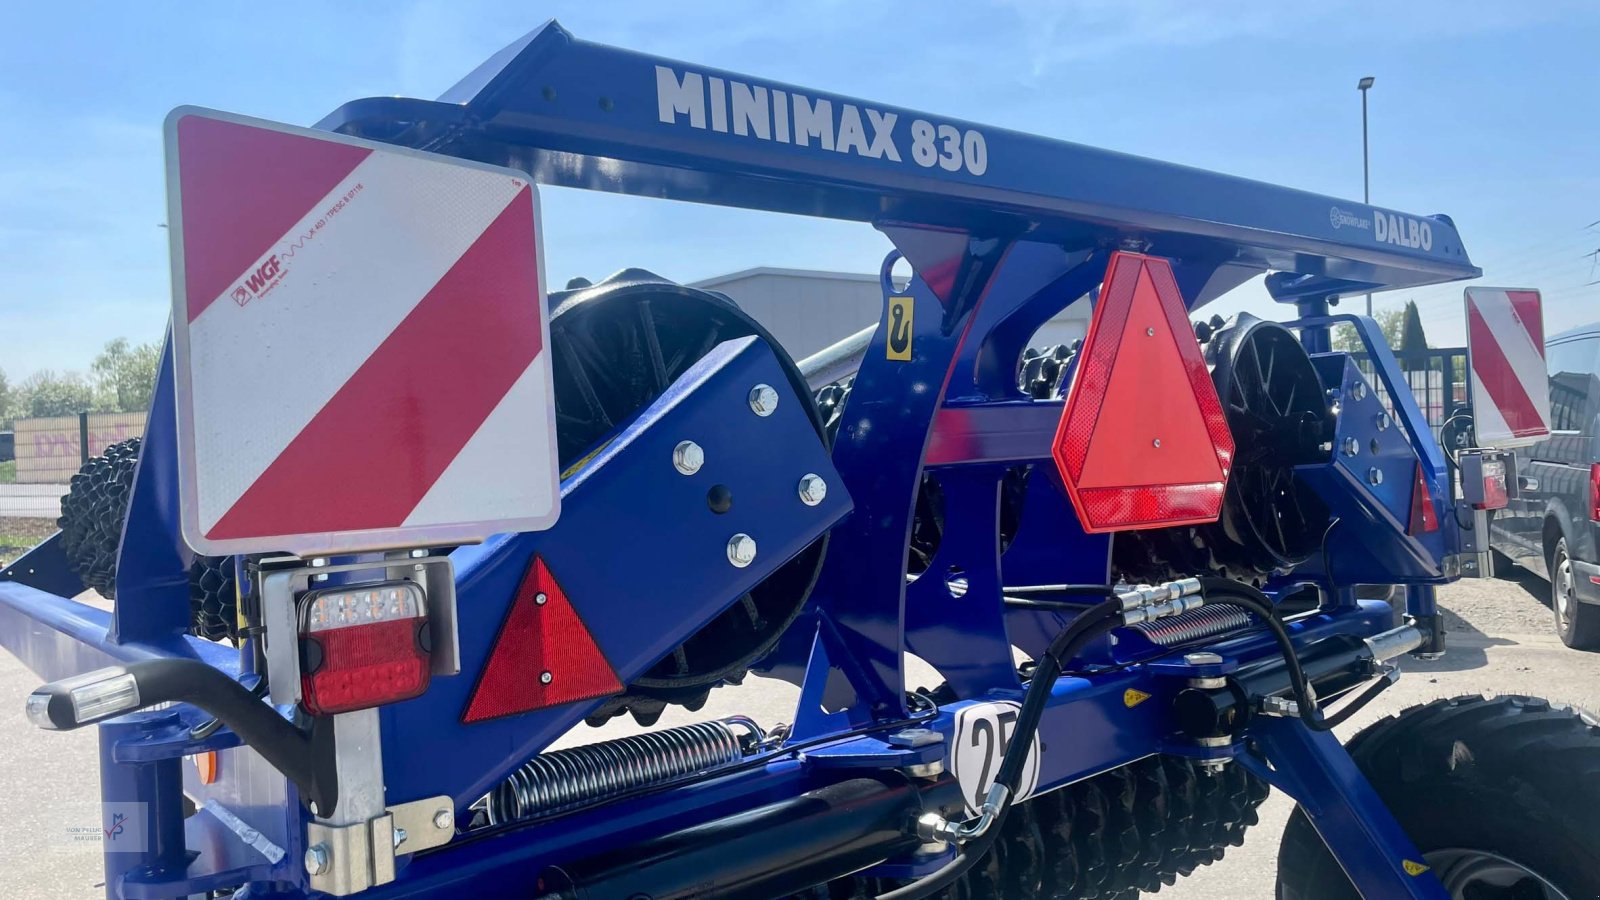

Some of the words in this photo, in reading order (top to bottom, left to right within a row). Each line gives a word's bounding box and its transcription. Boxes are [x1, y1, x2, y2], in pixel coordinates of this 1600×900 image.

[655, 65, 902, 162] MINIMAX
[911, 119, 988, 177] 830
[1373, 210, 1432, 252] DALBO
[245, 254, 280, 294] WGF
